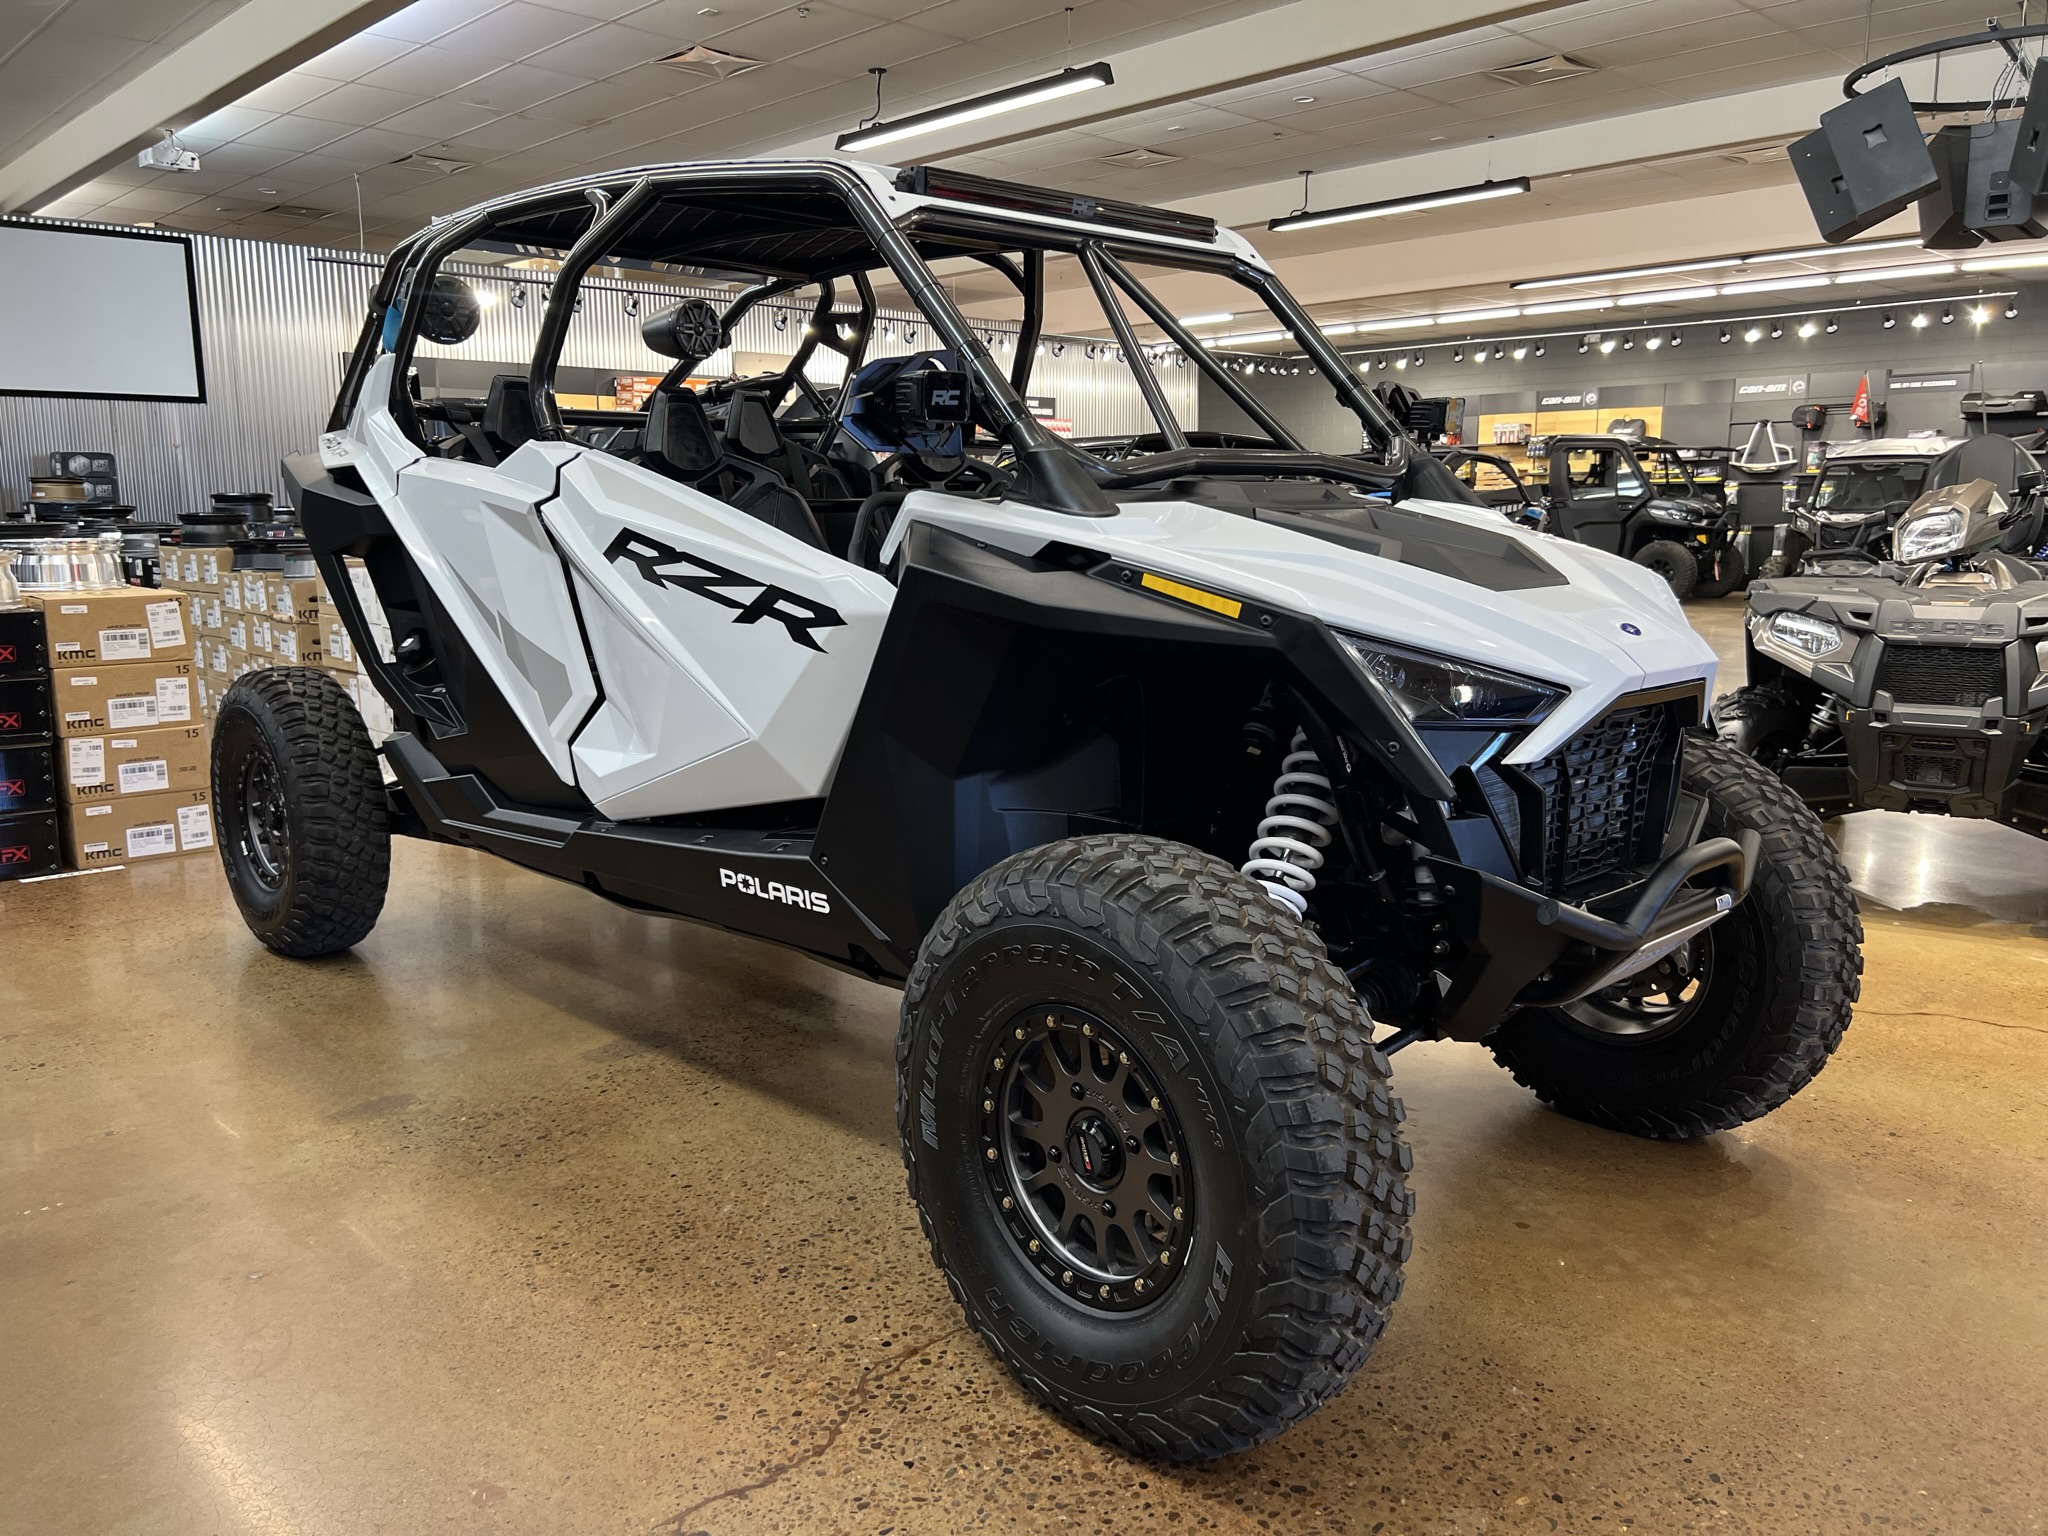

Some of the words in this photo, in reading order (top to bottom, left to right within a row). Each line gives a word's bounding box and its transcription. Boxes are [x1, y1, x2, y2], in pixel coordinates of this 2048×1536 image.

[931, 389, 960, 406] RC
[603, 527, 849, 654] RZR
[298, 610, 319, 619] KM
[1887, 620, 2006, 638] POLARIS
[302, 652, 322, 661] KM
[175, 665, 190, 675] 15
[185, 729, 199, 739] 15
[192, 792, 206, 801] 15
[719, 868, 830, 914] POLARIS
